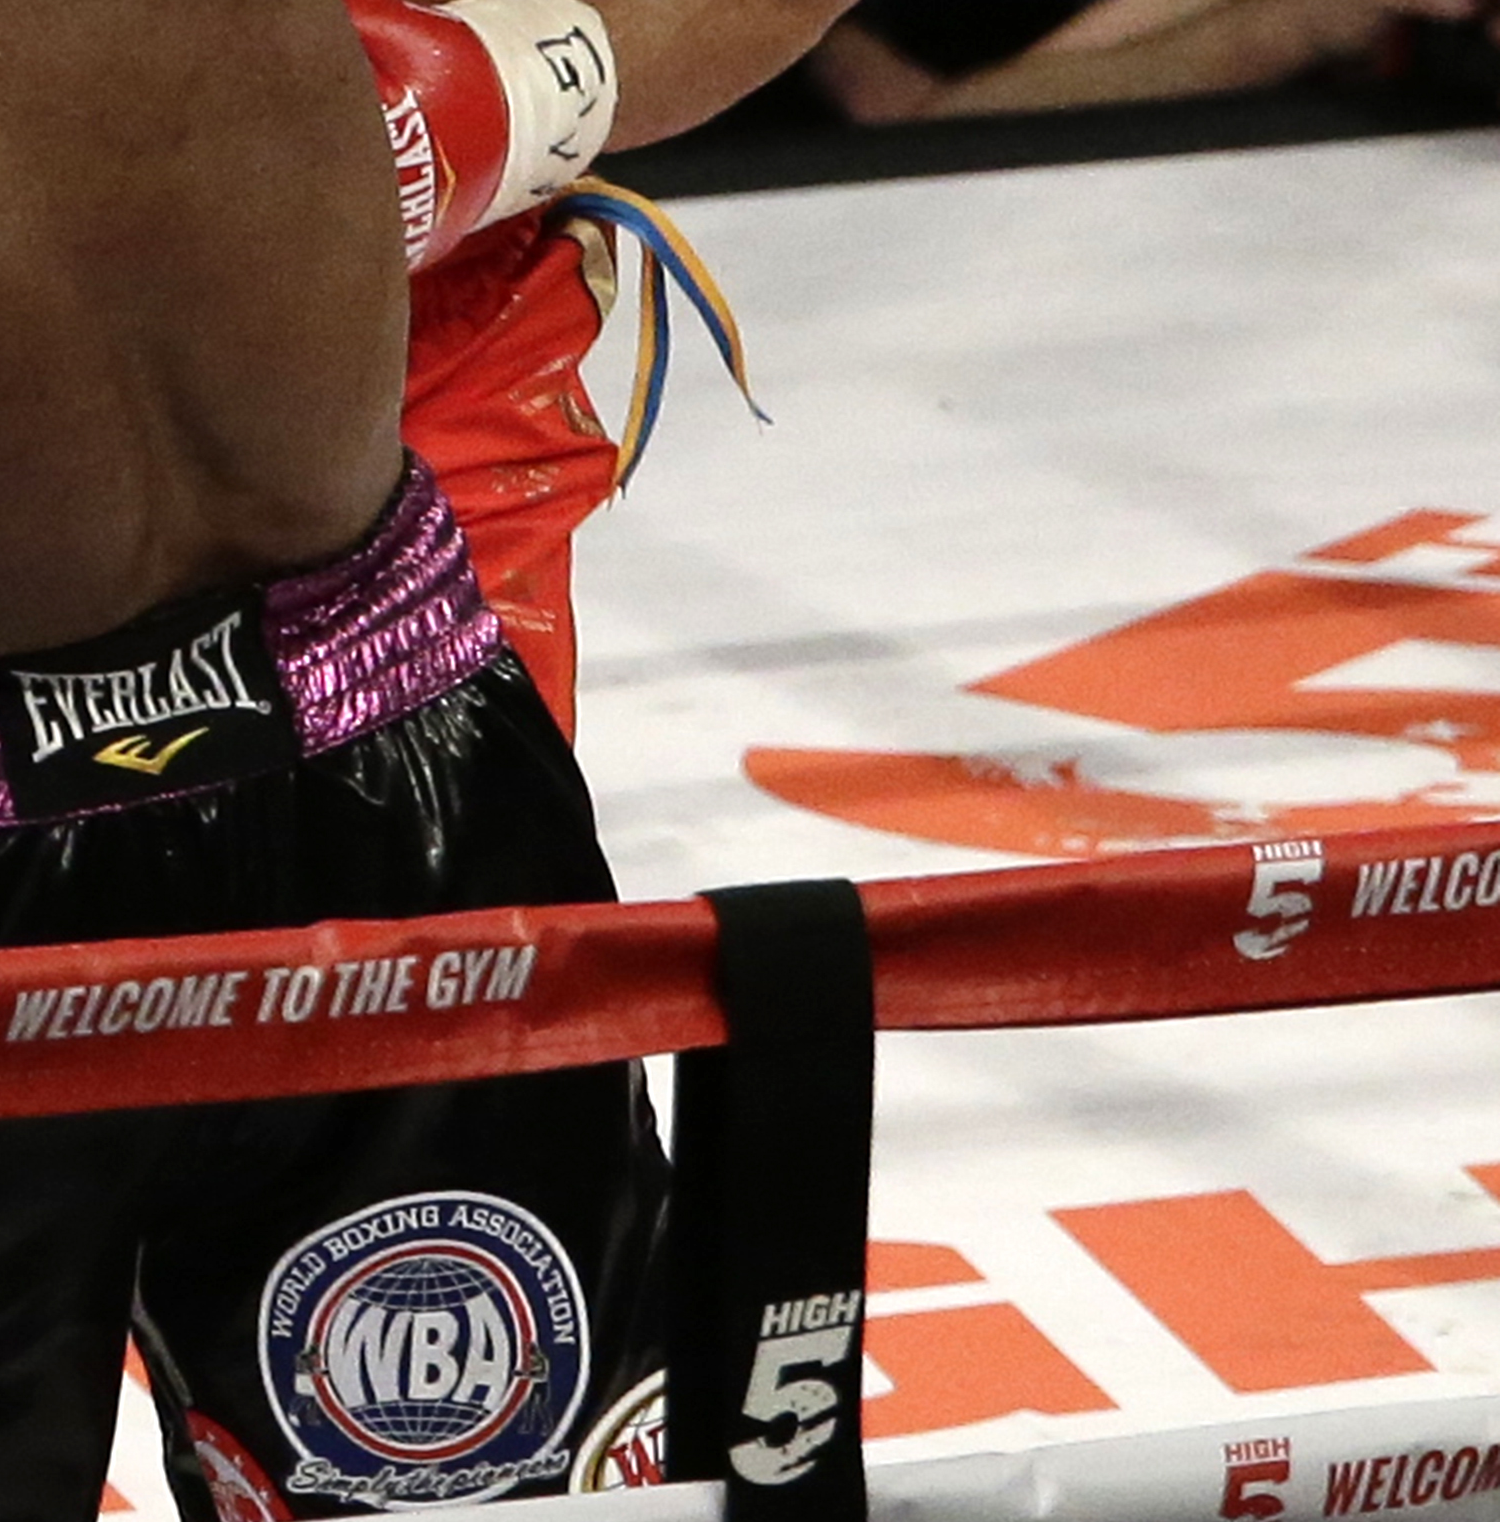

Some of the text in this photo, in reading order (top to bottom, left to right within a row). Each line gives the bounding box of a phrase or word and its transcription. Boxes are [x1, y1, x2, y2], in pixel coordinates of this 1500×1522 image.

[11, 611, 264, 762] EVERLAST
[1253, 840, 1323, 861] HIGH
[1233, 858, 1324, 960] 5
[6, 944, 538, 1043] WELCOME TO THE GYM
[270, 1203, 577, 1346] WORLD BOXING ASSOCIATION
[761, 1289, 862, 1338] HIGH
[328, 1290, 512, 1409] WBA
[728, 1325, 853, 1487] 5
[1224, 1436, 1291, 1462] HIGH
